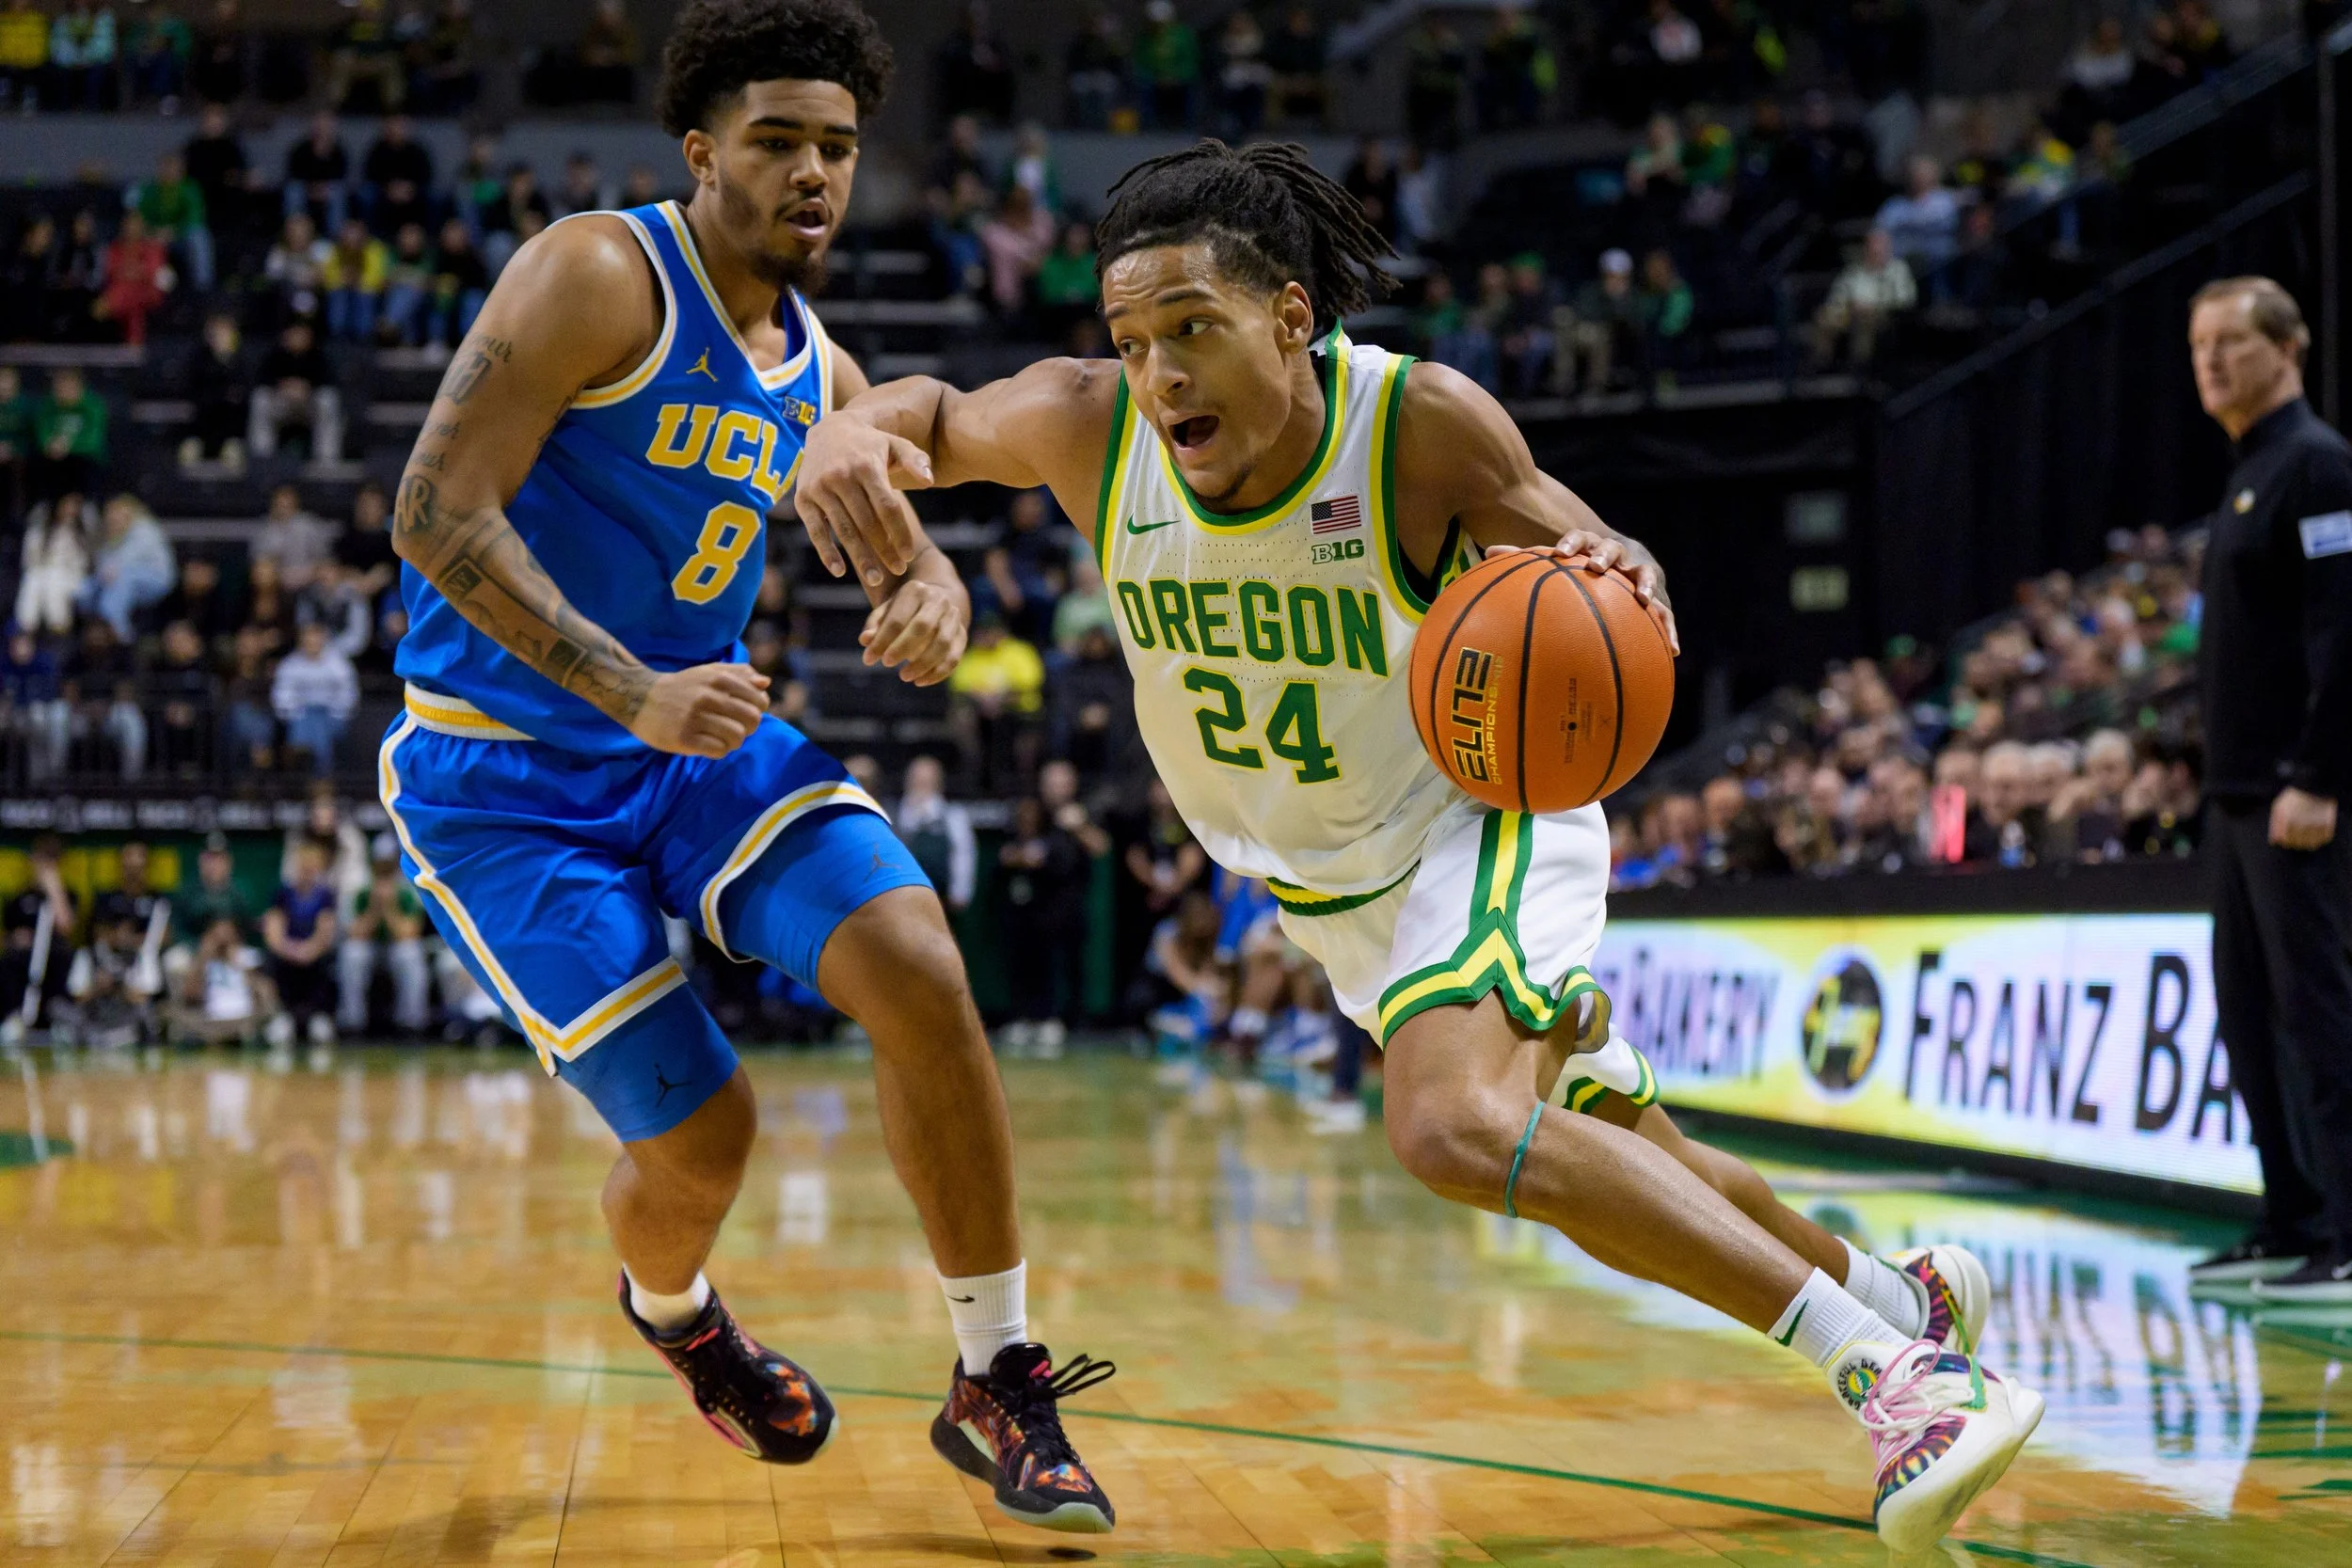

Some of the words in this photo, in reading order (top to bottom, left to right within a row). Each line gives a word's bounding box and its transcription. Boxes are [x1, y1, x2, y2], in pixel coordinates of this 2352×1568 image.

[671, 500, 761, 605] 8
[1117, 579, 1390, 678] OREGON
[1183, 664, 1342, 784] 24
[1451, 646, 1494, 783] ELITE
[1627, 946, 1779, 1084] BAKERY
[1904, 950, 2114, 1124] FRANZ
[2136, 954, 2254, 1146] BA
